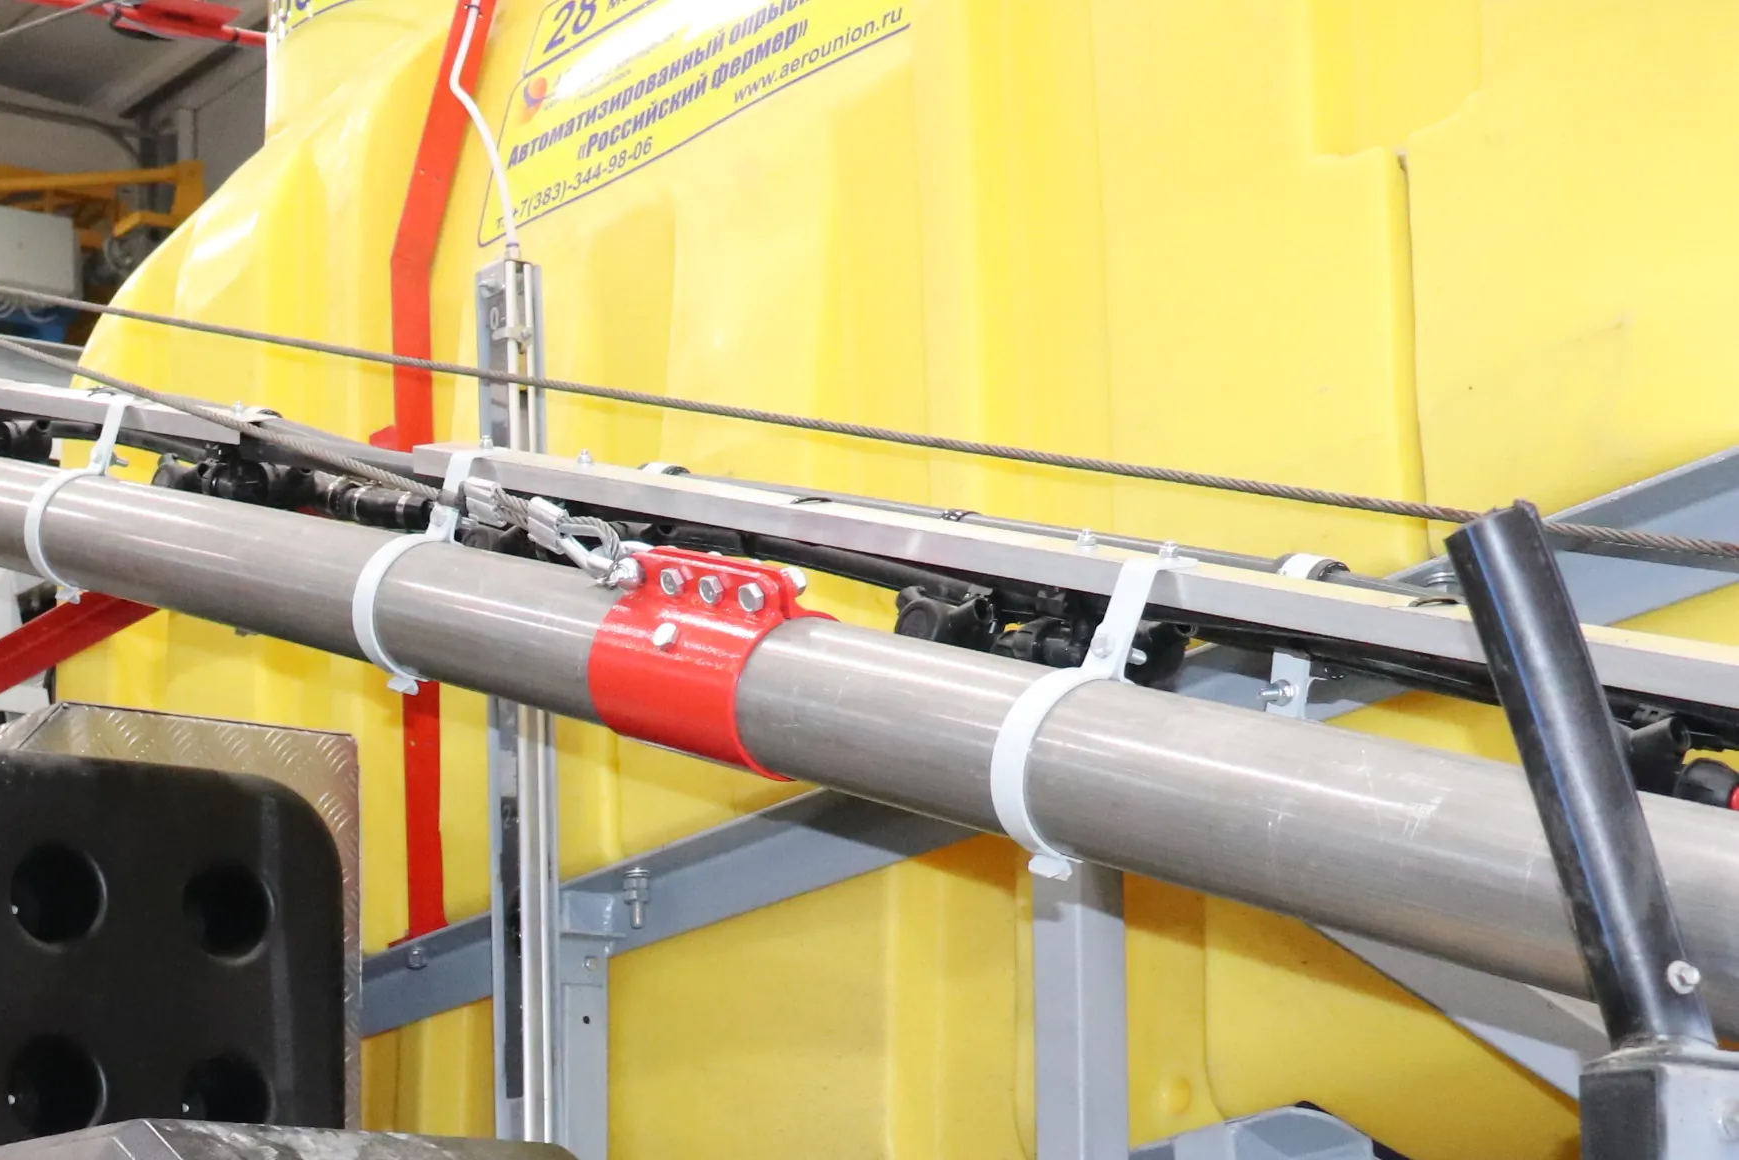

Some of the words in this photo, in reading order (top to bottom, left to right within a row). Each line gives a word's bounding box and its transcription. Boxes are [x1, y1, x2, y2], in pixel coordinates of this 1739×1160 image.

[543, 0, 597, 54] 28
[733, 7, 904, 104] www.aerounion.ru
[507, 28, 726, 170] Автоматизированный
[577, 72, 708, 161] «Российский
[711, 18, 809, 90] фермер»
